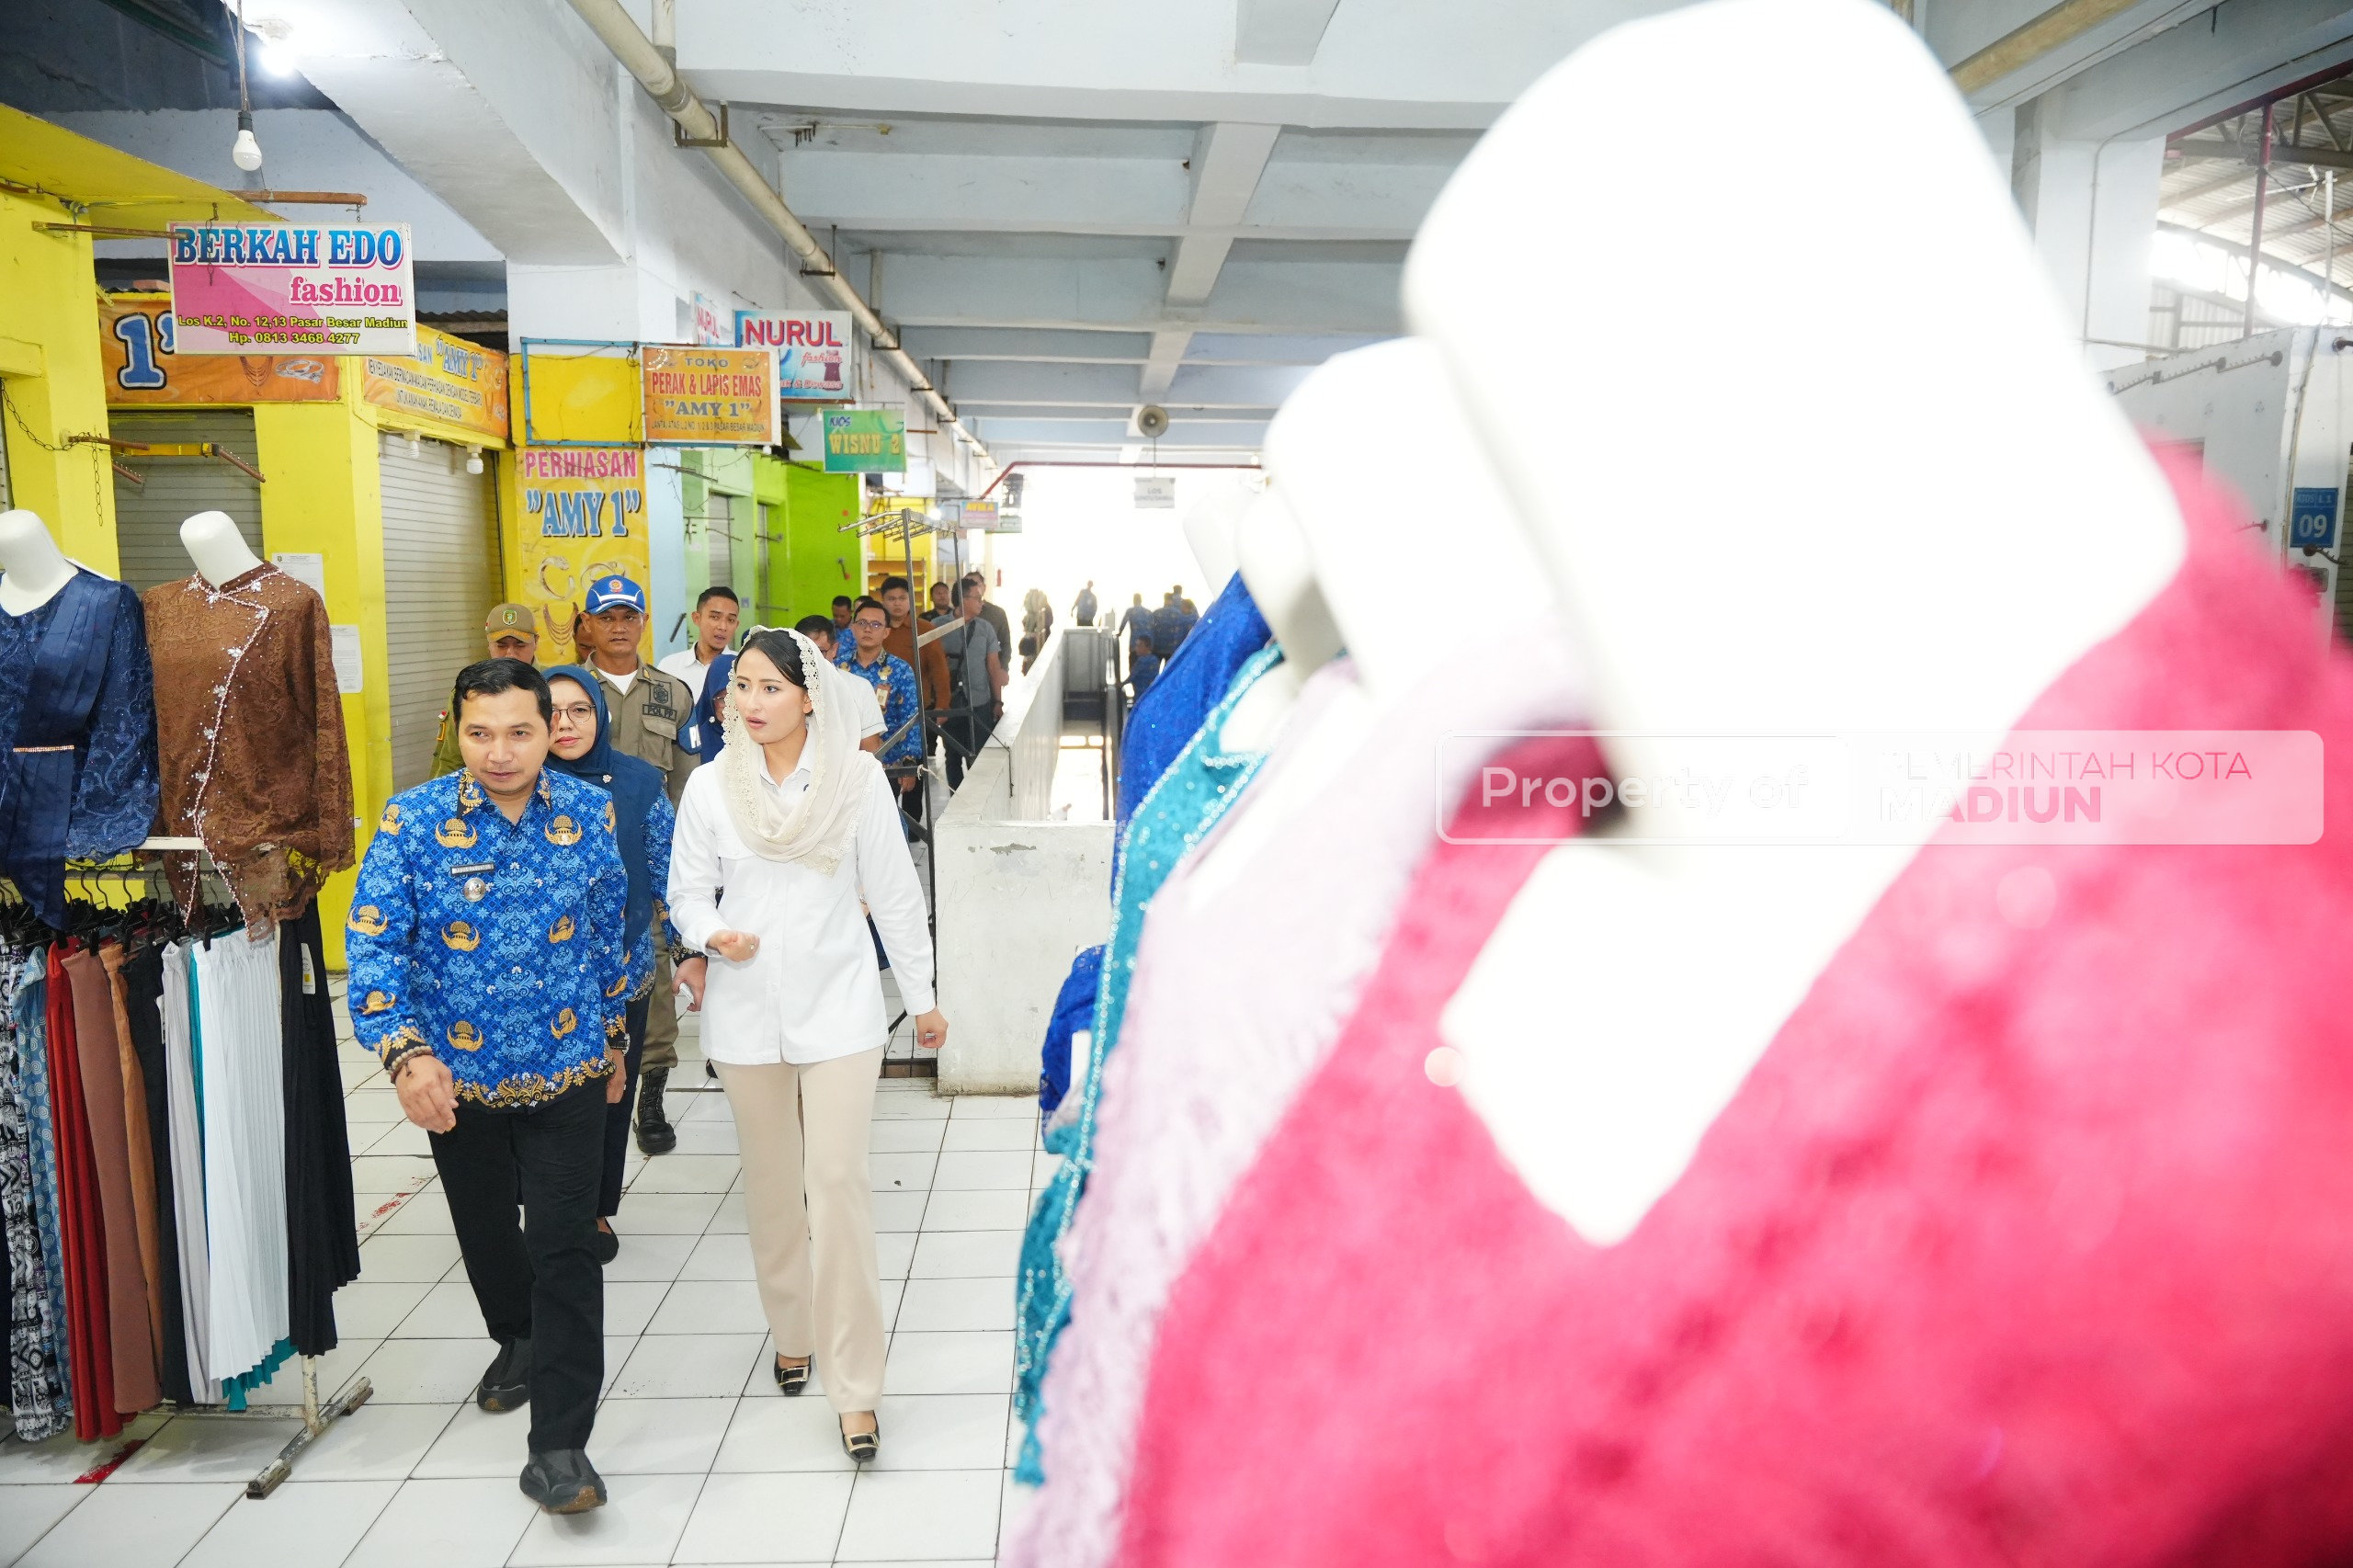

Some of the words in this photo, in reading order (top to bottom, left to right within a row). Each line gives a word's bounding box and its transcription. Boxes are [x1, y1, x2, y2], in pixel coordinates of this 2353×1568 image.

[175, 227, 319, 266] BERKAH
[327, 229, 403, 267] EDO
[290, 276, 401, 304] fashion
[178, 315, 200, 327] Los
[203, 315, 227, 328] K.2,
[230, 315, 252, 327] No.
[255, 315, 287, 328] 12,13
[290, 316, 324, 328] Pasar
[326, 317, 362, 328] Besar
[364, 317, 408, 329] Madiun
[745, 319, 843, 347] NURUL
[229, 332, 252, 345] Hp.
[255, 333, 288, 344] 0813
[291, 333, 324, 344] 3468
[327, 333, 361, 344] 4277
[685, 358, 729, 368] TOKO
[801, 351, 843, 367] fashion
[652, 372, 686, 395] PERAK
[689, 373, 697, 395] &
[699, 373, 730, 396] LAPIS
[733, 375, 762, 397] EMAS
[828, 433, 881, 455] WISNU
[890, 433, 901, 455] 2
[525, 450, 638, 479] PERHIASAN
[2299, 514, 2327, 538] 09
